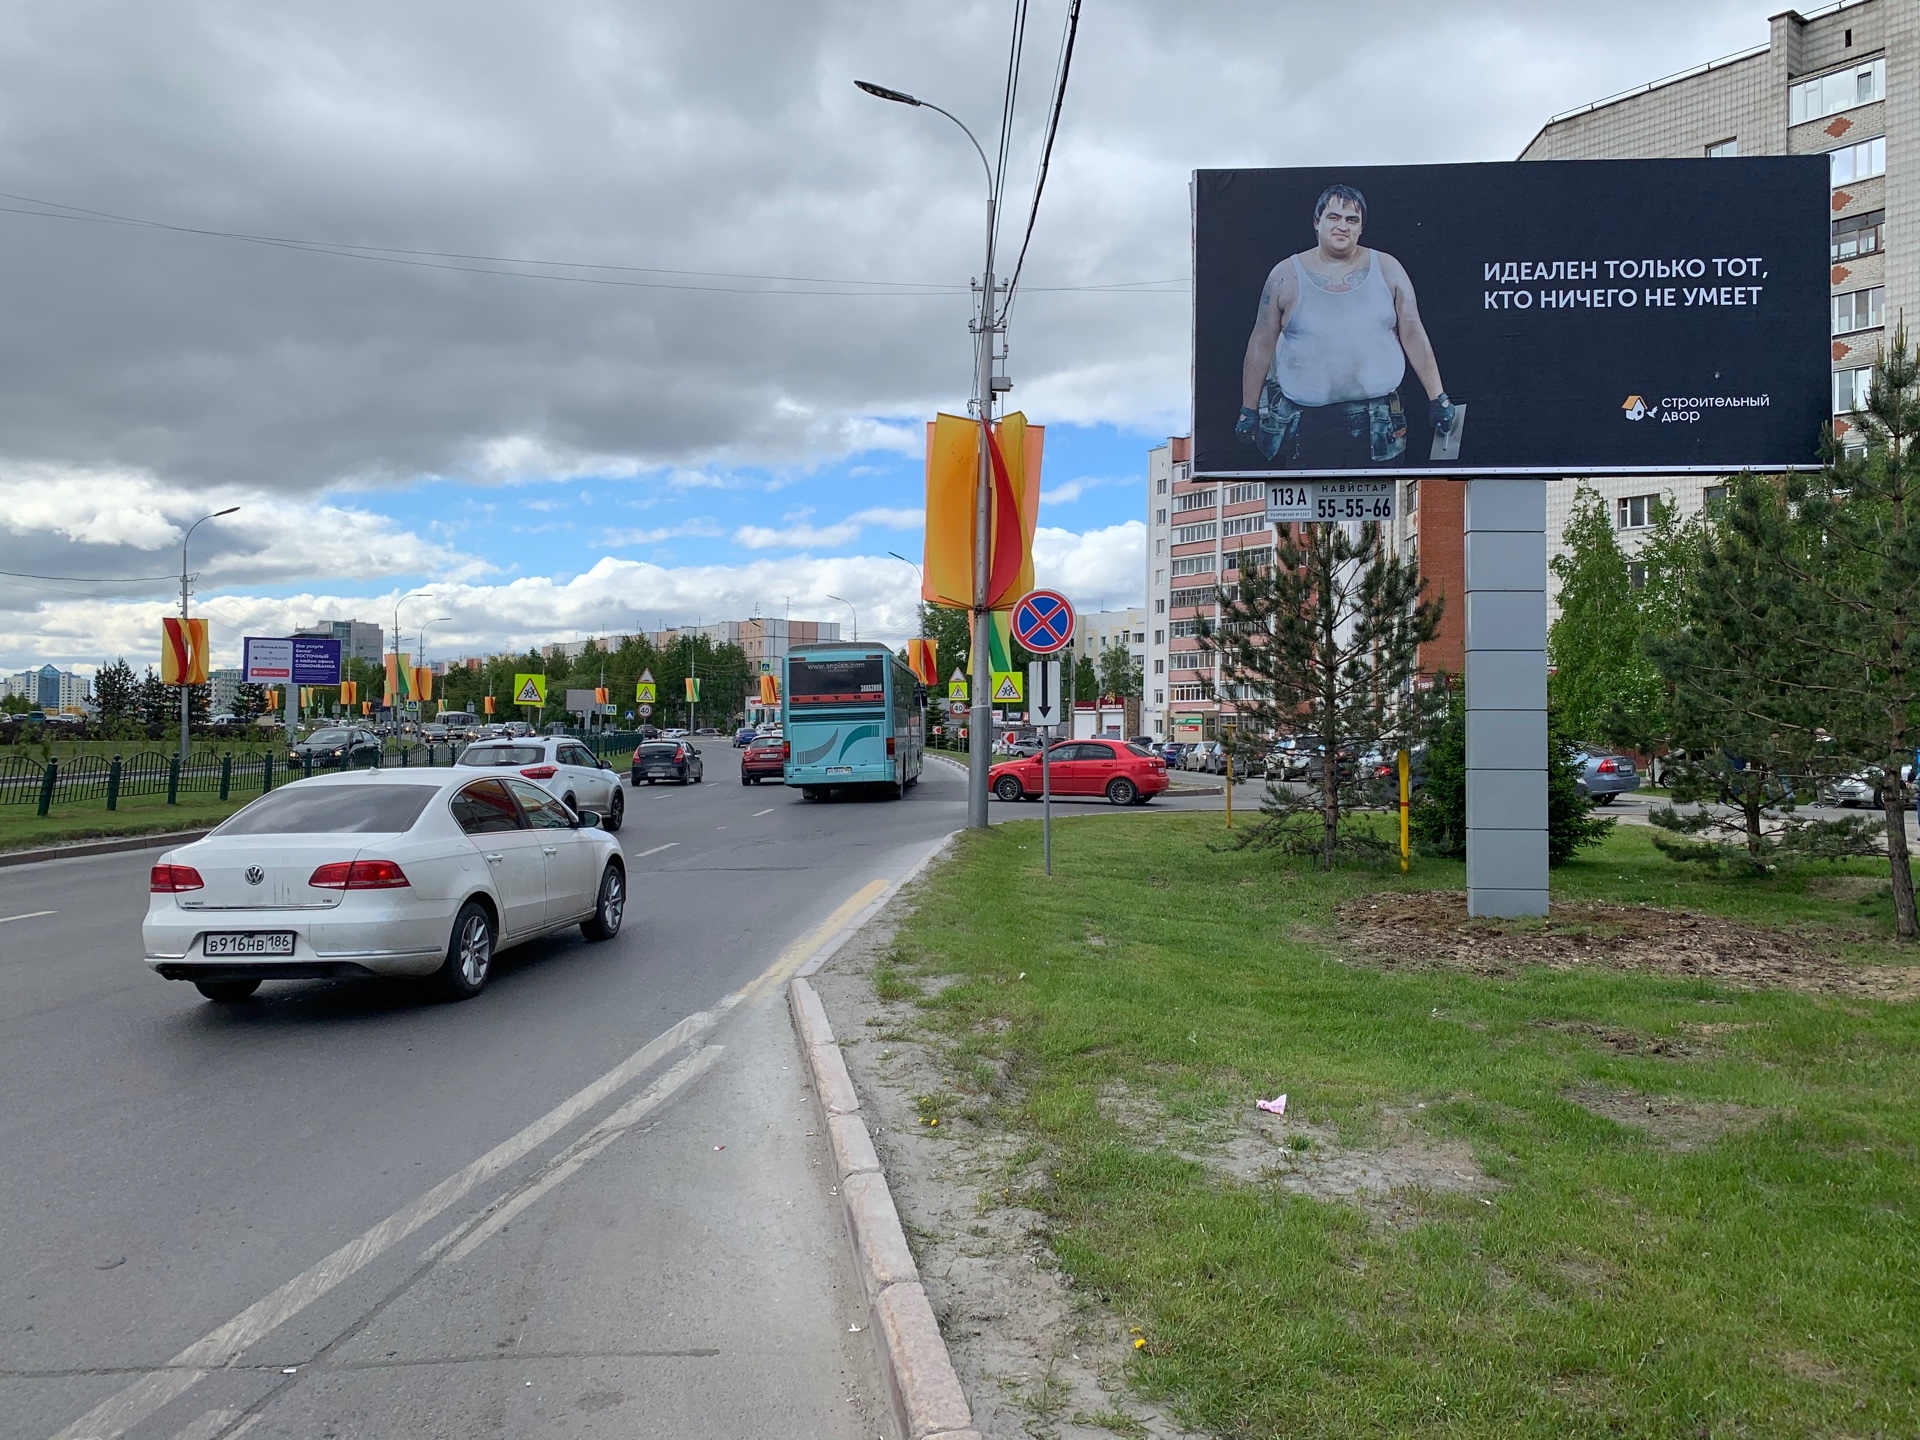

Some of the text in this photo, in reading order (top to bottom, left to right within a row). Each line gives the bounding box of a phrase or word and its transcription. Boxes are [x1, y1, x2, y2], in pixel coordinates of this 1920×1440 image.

[1484, 257, 1769, 284] ИДЕАЛЕН ТОЛЬКО ТОТ,
[1484, 286, 1763, 309] КТО НИЧЕГО НЕ УМЕЕТ
[1661, 394, 1770, 411] строительный
[1661, 409, 1701, 423] двор
[1271, 487, 1308, 506] 113 А
[1321, 483, 1388, 493] НАВИСТАР
[1317, 498, 1391, 518] 55-55-66
[640, 706, 650, 715] 40
[268, 935, 289, 947] 186
